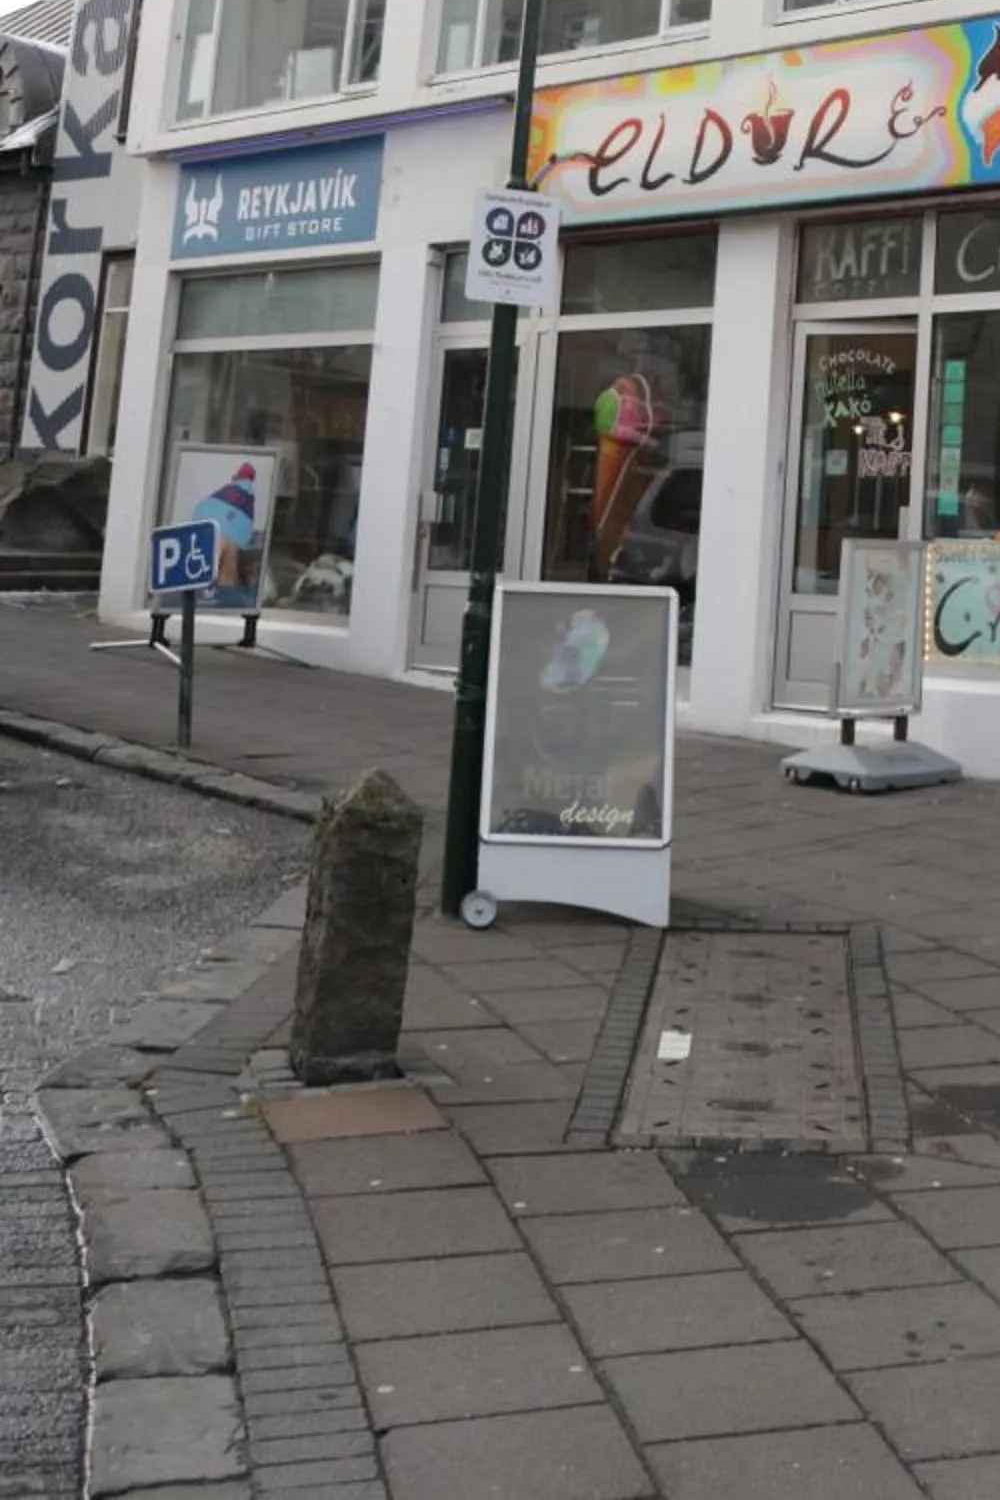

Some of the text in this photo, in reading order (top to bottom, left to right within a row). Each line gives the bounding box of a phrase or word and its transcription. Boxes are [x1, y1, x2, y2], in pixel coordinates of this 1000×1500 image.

[237, 168, 358, 220] REYKJAVÍK
[245, 217, 343, 241] GIFT STORE
[818, 349, 897, 375] CHOCOLATE
[158, 538, 181, 584] P
[559, 800, 635, 834] design
